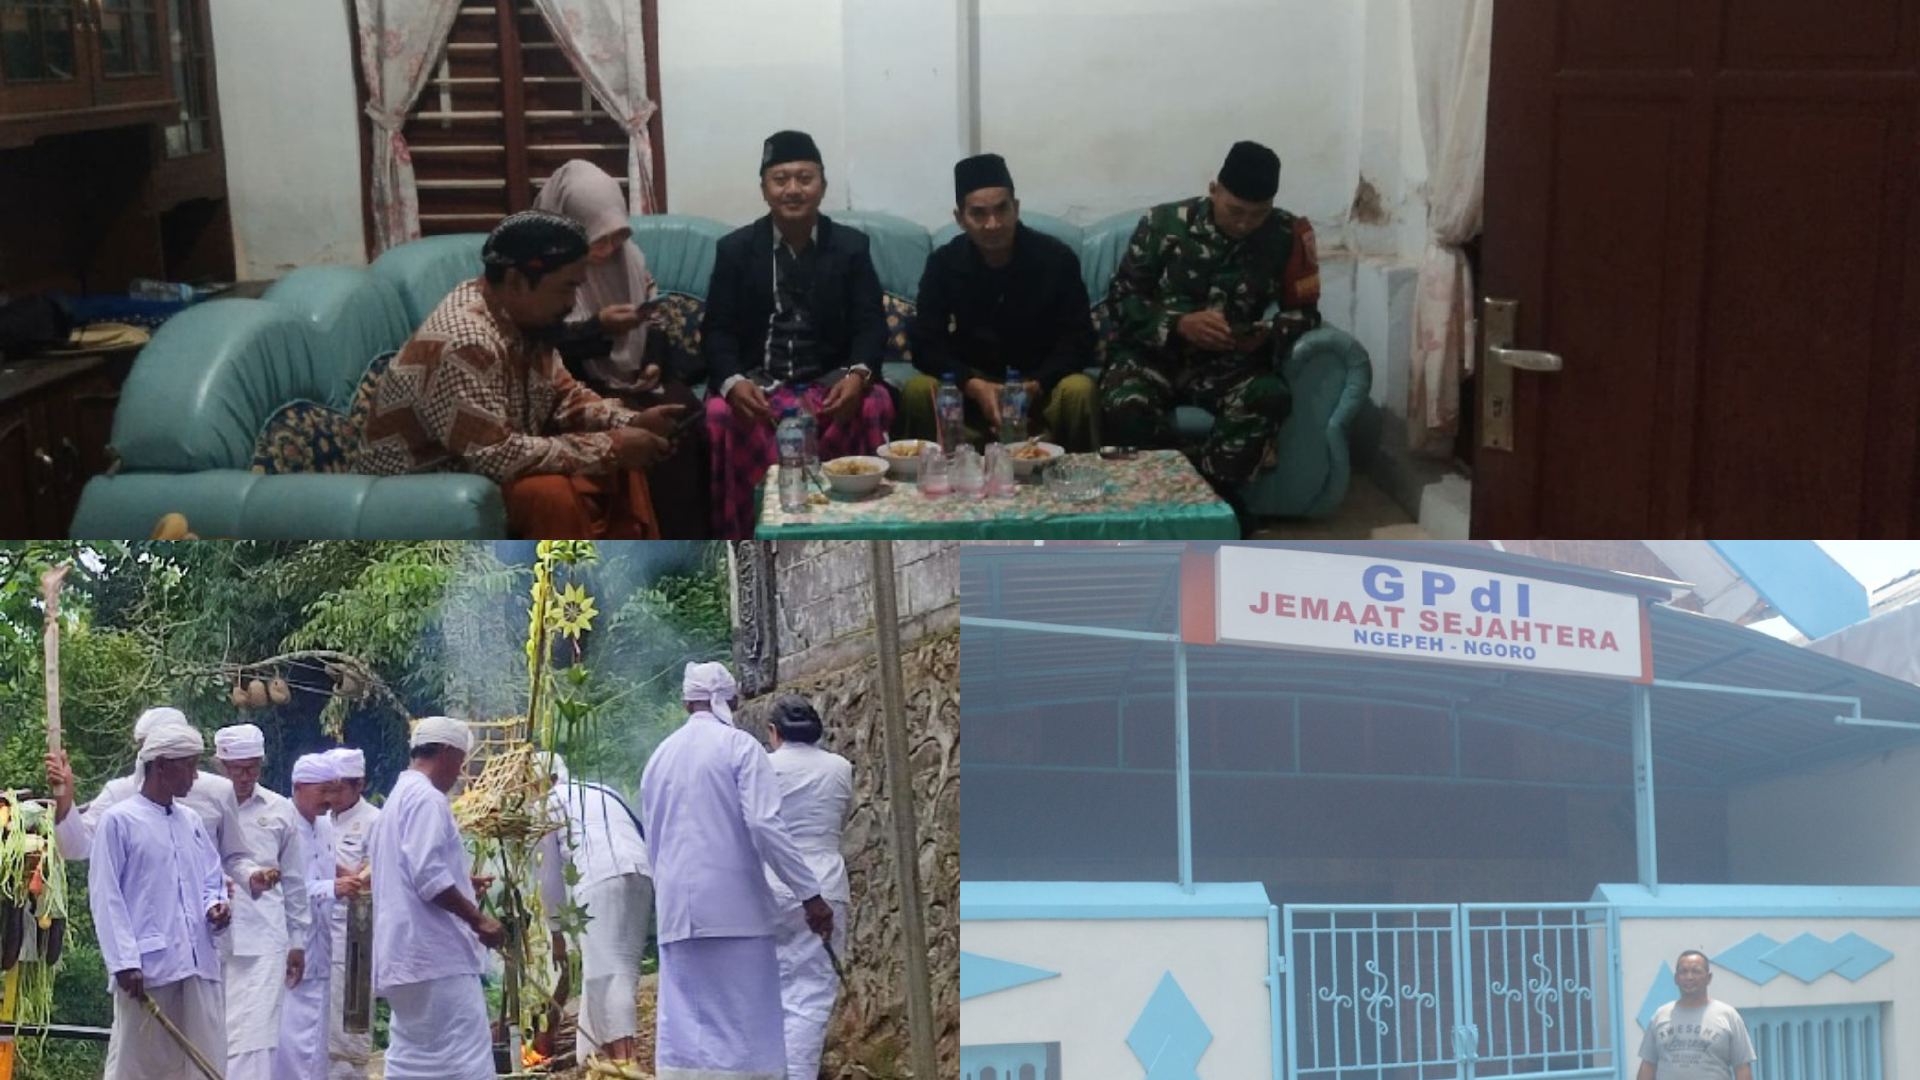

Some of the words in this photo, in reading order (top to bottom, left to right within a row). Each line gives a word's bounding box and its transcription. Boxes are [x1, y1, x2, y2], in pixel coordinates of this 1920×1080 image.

[1249, 592, 1406, 629] JEMAAT
[1418, 610, 1619, 652] SEJAHTERA
[1354, 629, 1444, 652] NGEPEH
[1464, 642, 1536, 661] NGORO
[1659, 1024, 1721, 1041] AWESOME
